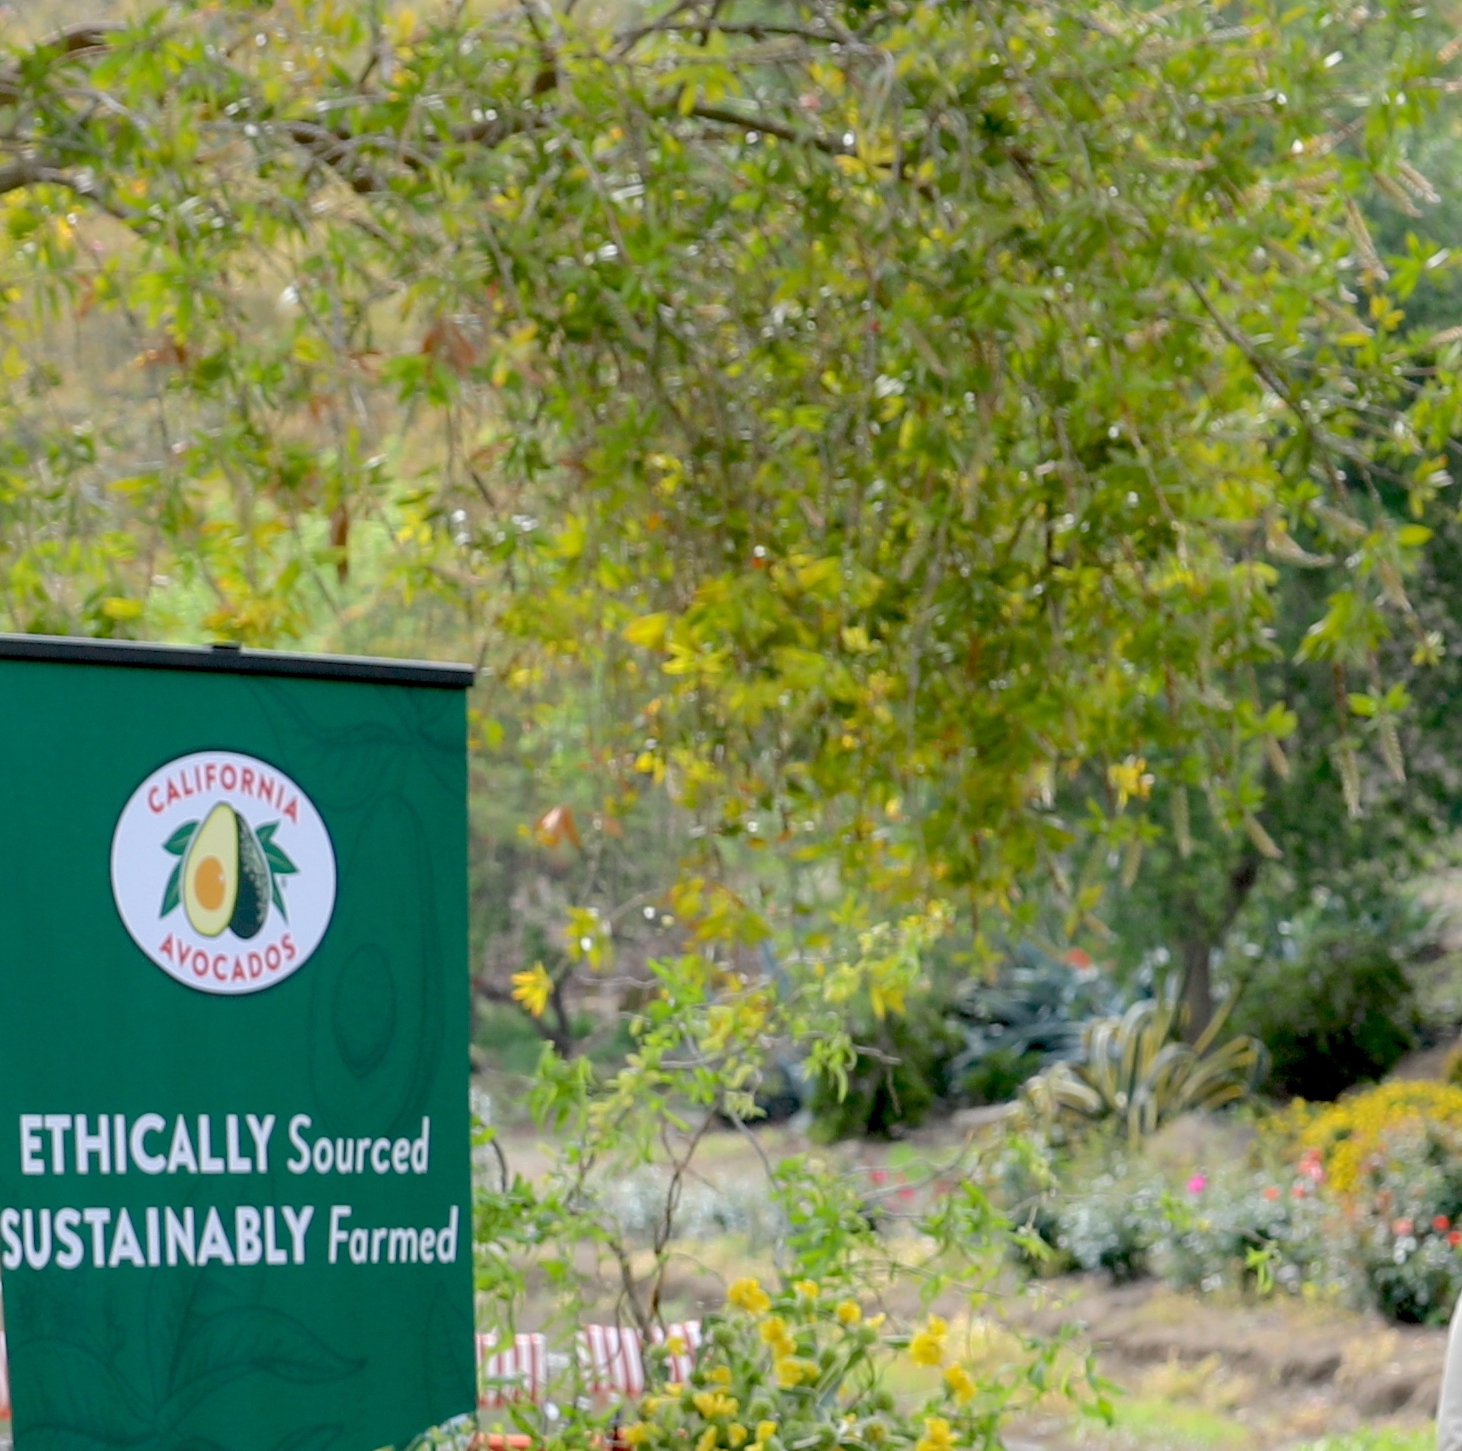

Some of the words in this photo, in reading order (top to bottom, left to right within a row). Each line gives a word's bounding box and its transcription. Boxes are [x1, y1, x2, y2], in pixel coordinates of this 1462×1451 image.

[147, 763, 299, 824] CALIFORNIA
[159, 932, 298, 983] AVOCADOS
[19, 1112, 275, 1176] ETHICALLY
[287, 1114, 430, 1175] Sourced
[0, 1206, 314, 1271] SUSTAINABLY
[328, 1205, 460, 1265] Farmed
